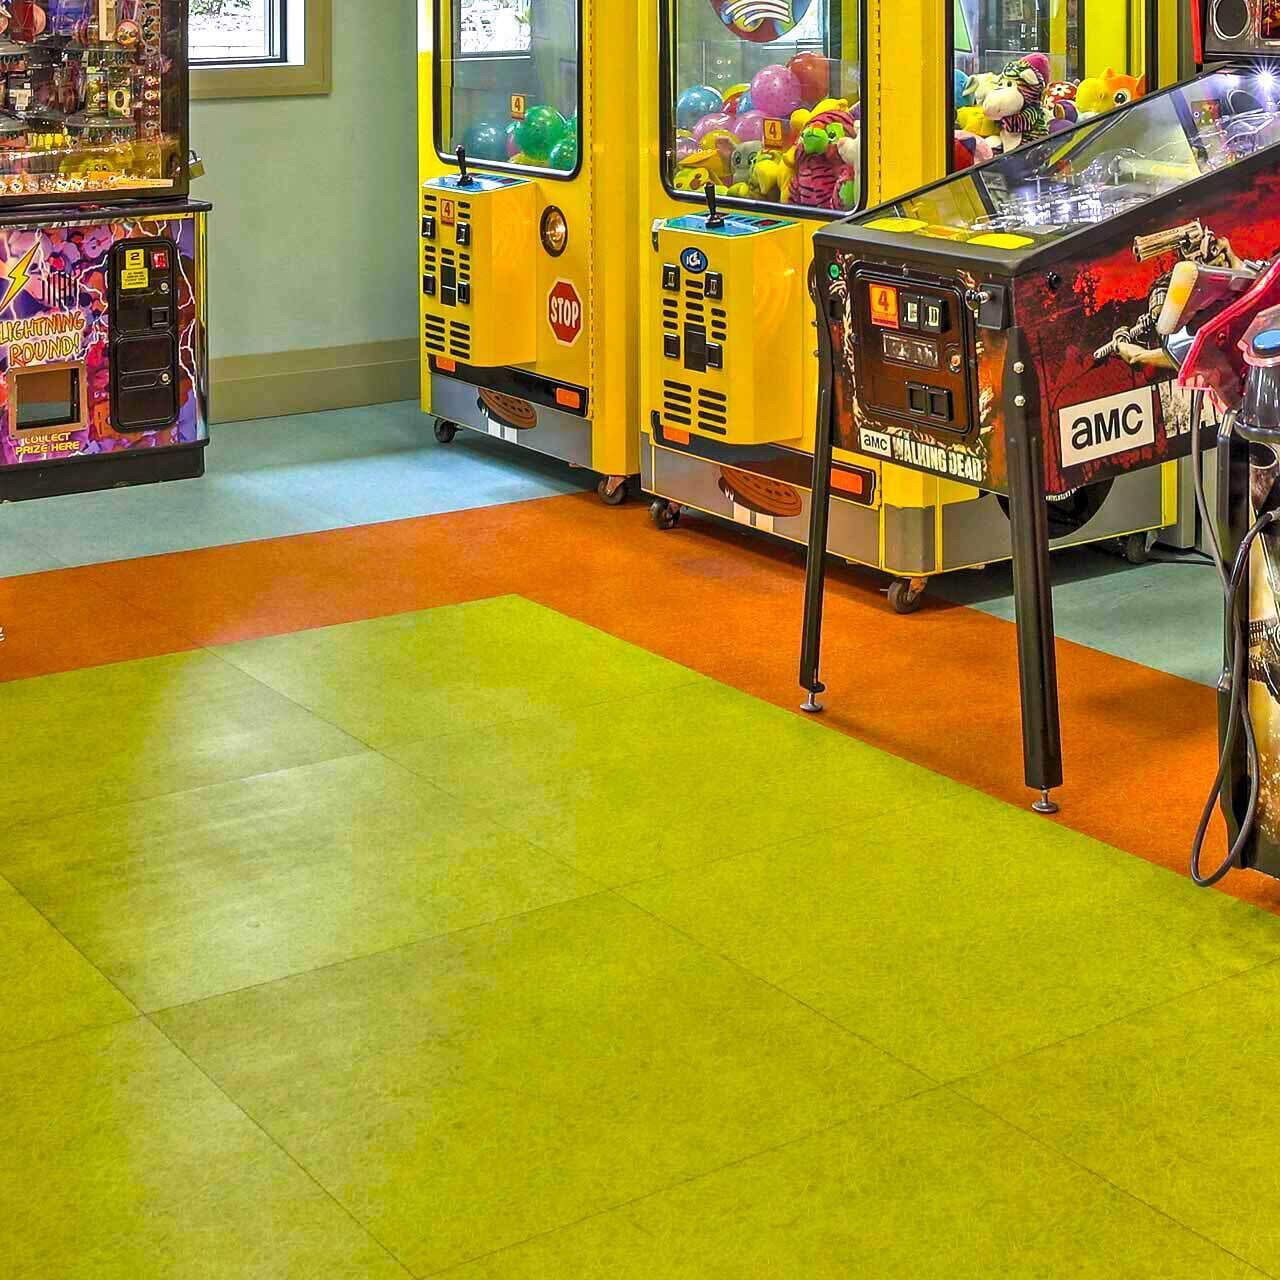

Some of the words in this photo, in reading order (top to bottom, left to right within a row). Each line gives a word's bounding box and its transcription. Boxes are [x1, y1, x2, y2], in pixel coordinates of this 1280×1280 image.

[514, 97, 521, 111] 4
[769, 122, 778, 139] 4
[443, 202, 451, 217] 4
[130, 252, 140, 261] 2
[877, 290, 890, 311] 4
[550, 297, 579, 328] STOP
[9, 333, 80, 367] ROUND!
[23, 432, 71, 445] COLLECT
[15, 443, 48, 456] PRIZE
[50, 441, 80, 452] HERE
[892, 436, 947, 473] WALKING
[948, 451, 984, 482] DEAD
